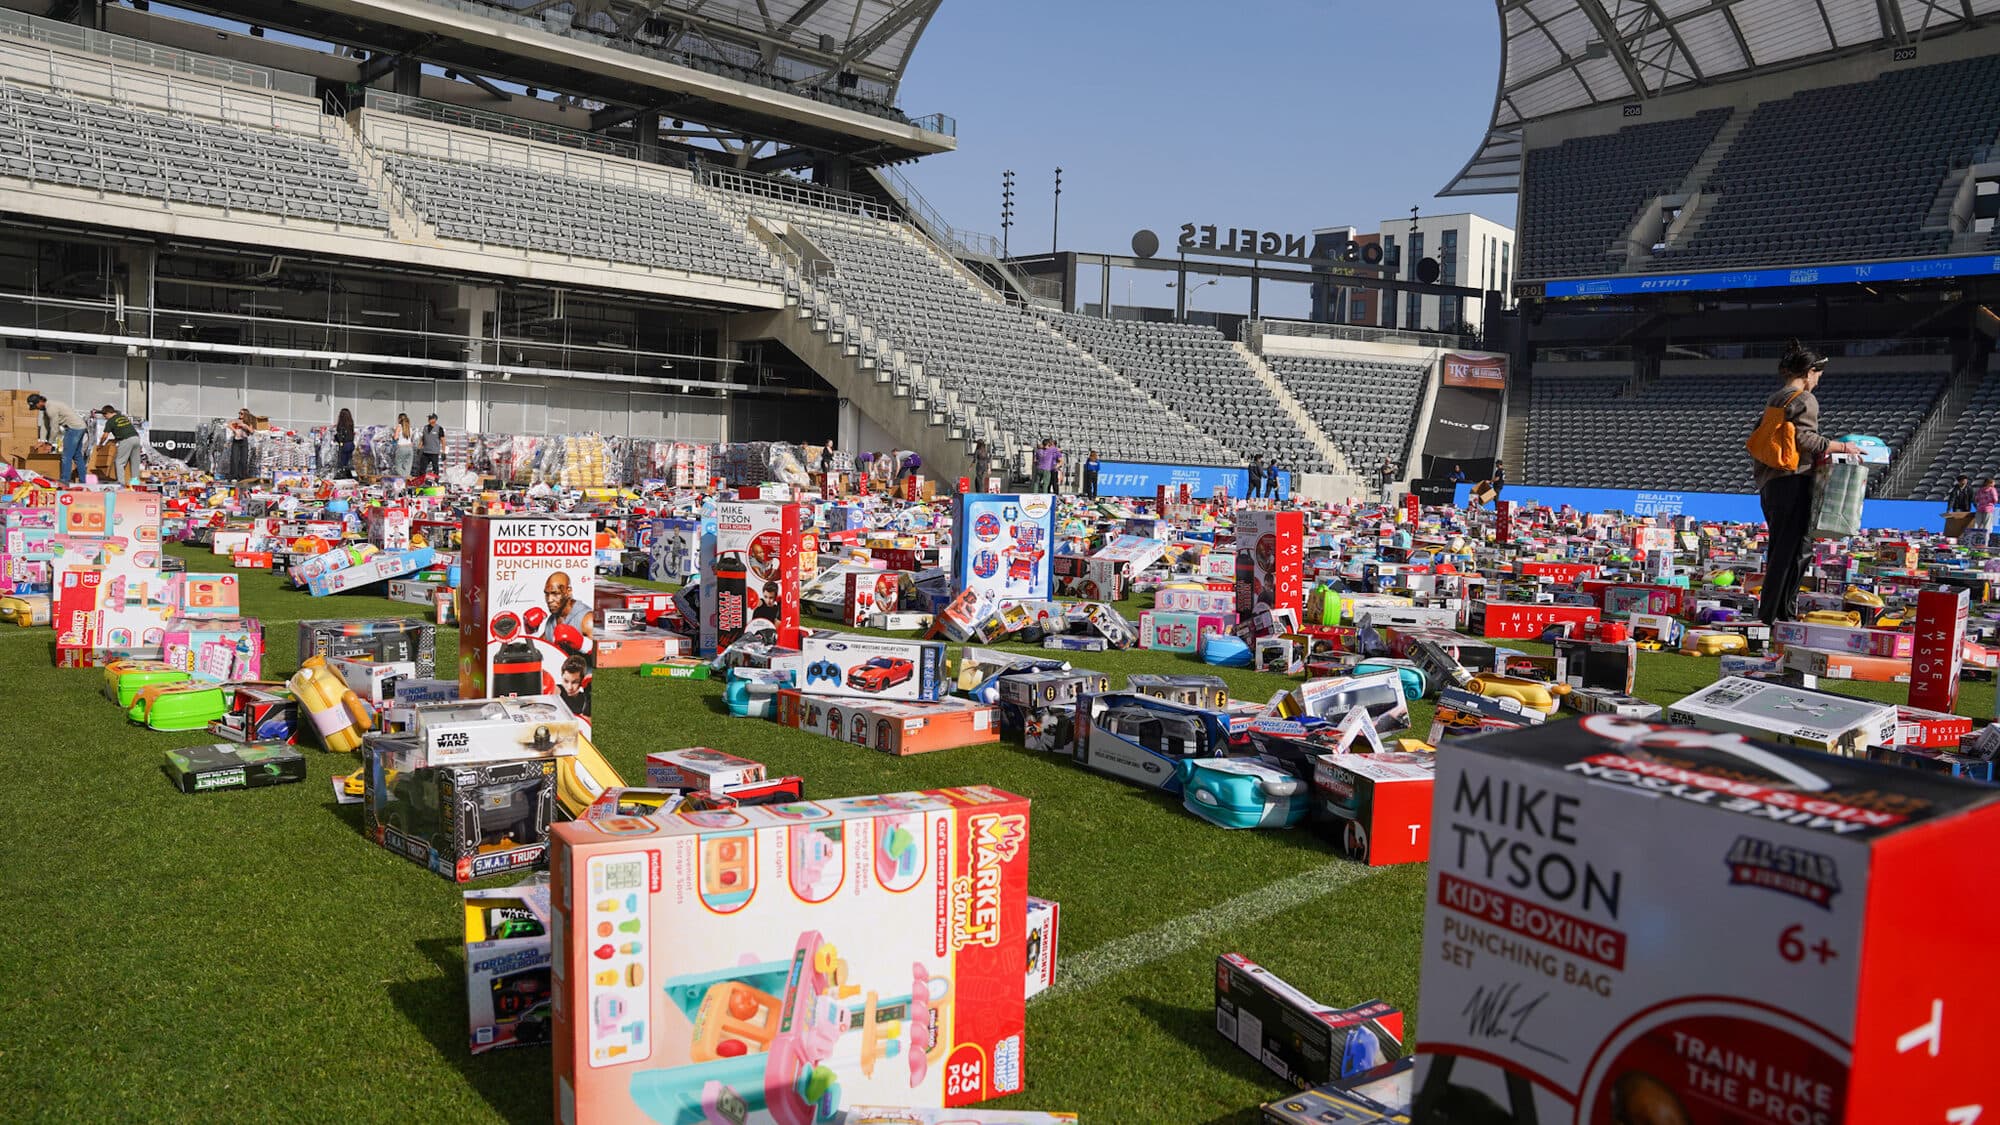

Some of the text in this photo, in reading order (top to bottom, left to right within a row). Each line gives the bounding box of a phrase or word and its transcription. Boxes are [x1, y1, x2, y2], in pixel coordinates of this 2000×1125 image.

[1896, 50, 1915, 60] 209
[1517, 286, 1542, 296] 12:01
[1641, 279, 1692, 288] RITFIT
[1097, 474, 1149, 487] RITFIT
[721, 506, 743, 515] MIKE
[721, 515, 750, 523] TYSON
[1634, 502, 1682, 517] GAMES
[498, 524, 589, 537] MIKE TYSON
[496, 542, 590, 554] KID'S BOXING
[496, 558, 589, 569] PUNCHING BAG
[496, 571, 517, 581] SET
[581, 575, 592, 583] 6+
[719, 591, 731, 631] TYSON
[730, 595, 742, 629] MIKE
[1512, 613, 1556, 621] MIKE
[1500, 623, 1540, 632] TYS
[400, 641, 408, 661] LICE
[1917, 617, 1935, 691] TYSON
[1932, 630, 1947, 680] MIKE
[651, 667, 695, 677] SUBWAY
[437, 740, 469, 749] WARS
[440, 732, 469, 741] STAR
[198, 775, 246, 789] HORNET
[1317, 762, 1333, 775] MIKE
[1333, 767, 1355, 784] TYSON
[1563, 761, 1718, 804] TYSON
[1452, 770, 1580, 846] MIKE
[1718, 800, 1868, 834] MIKE
[861, 821, 870, 849] Plenty
[994, 820, 1022, 857] My
[476, 848, 542, 871] S.W.A.T. TRUCK
[651, 851, 661, 892] Includes
[675, 839, 684, 905] Storage Spots
[685, 839, 693, 891] Convenient
[775, 853, 783, 880] Lights
[1449, 824, 1622, 920] TYSON
[1727, 835, 1840, 891] ALL-STAR
[853, 863, 861, 897] Makeup
[861, 863, 870, 889] Space
[935, 821, 948, 953] Kid's Grocery Store Playset
[976, 816, 998, 942] MARKET
[952, 880, 974, 948] Stand
[1444, 878, 1618, 964] KID'S BOXING
[1439, 941, 1475, 972] SET
[1442, 917, 1614, 998] PUNCHING BAG
[1777, 924, 1839, 969] 6+
[948, 1064, 961, 1096] PCS
[961, 1061, 980, 1093] 33
[995, 1050, 1007, 1085] ZONE
[1007, 1037, 1019, 1091] IMAGINE
[1672, 1030, 1834, 1111] TRAIN LIKE
[1685, 1062, 1833, 1125] THE PROS
